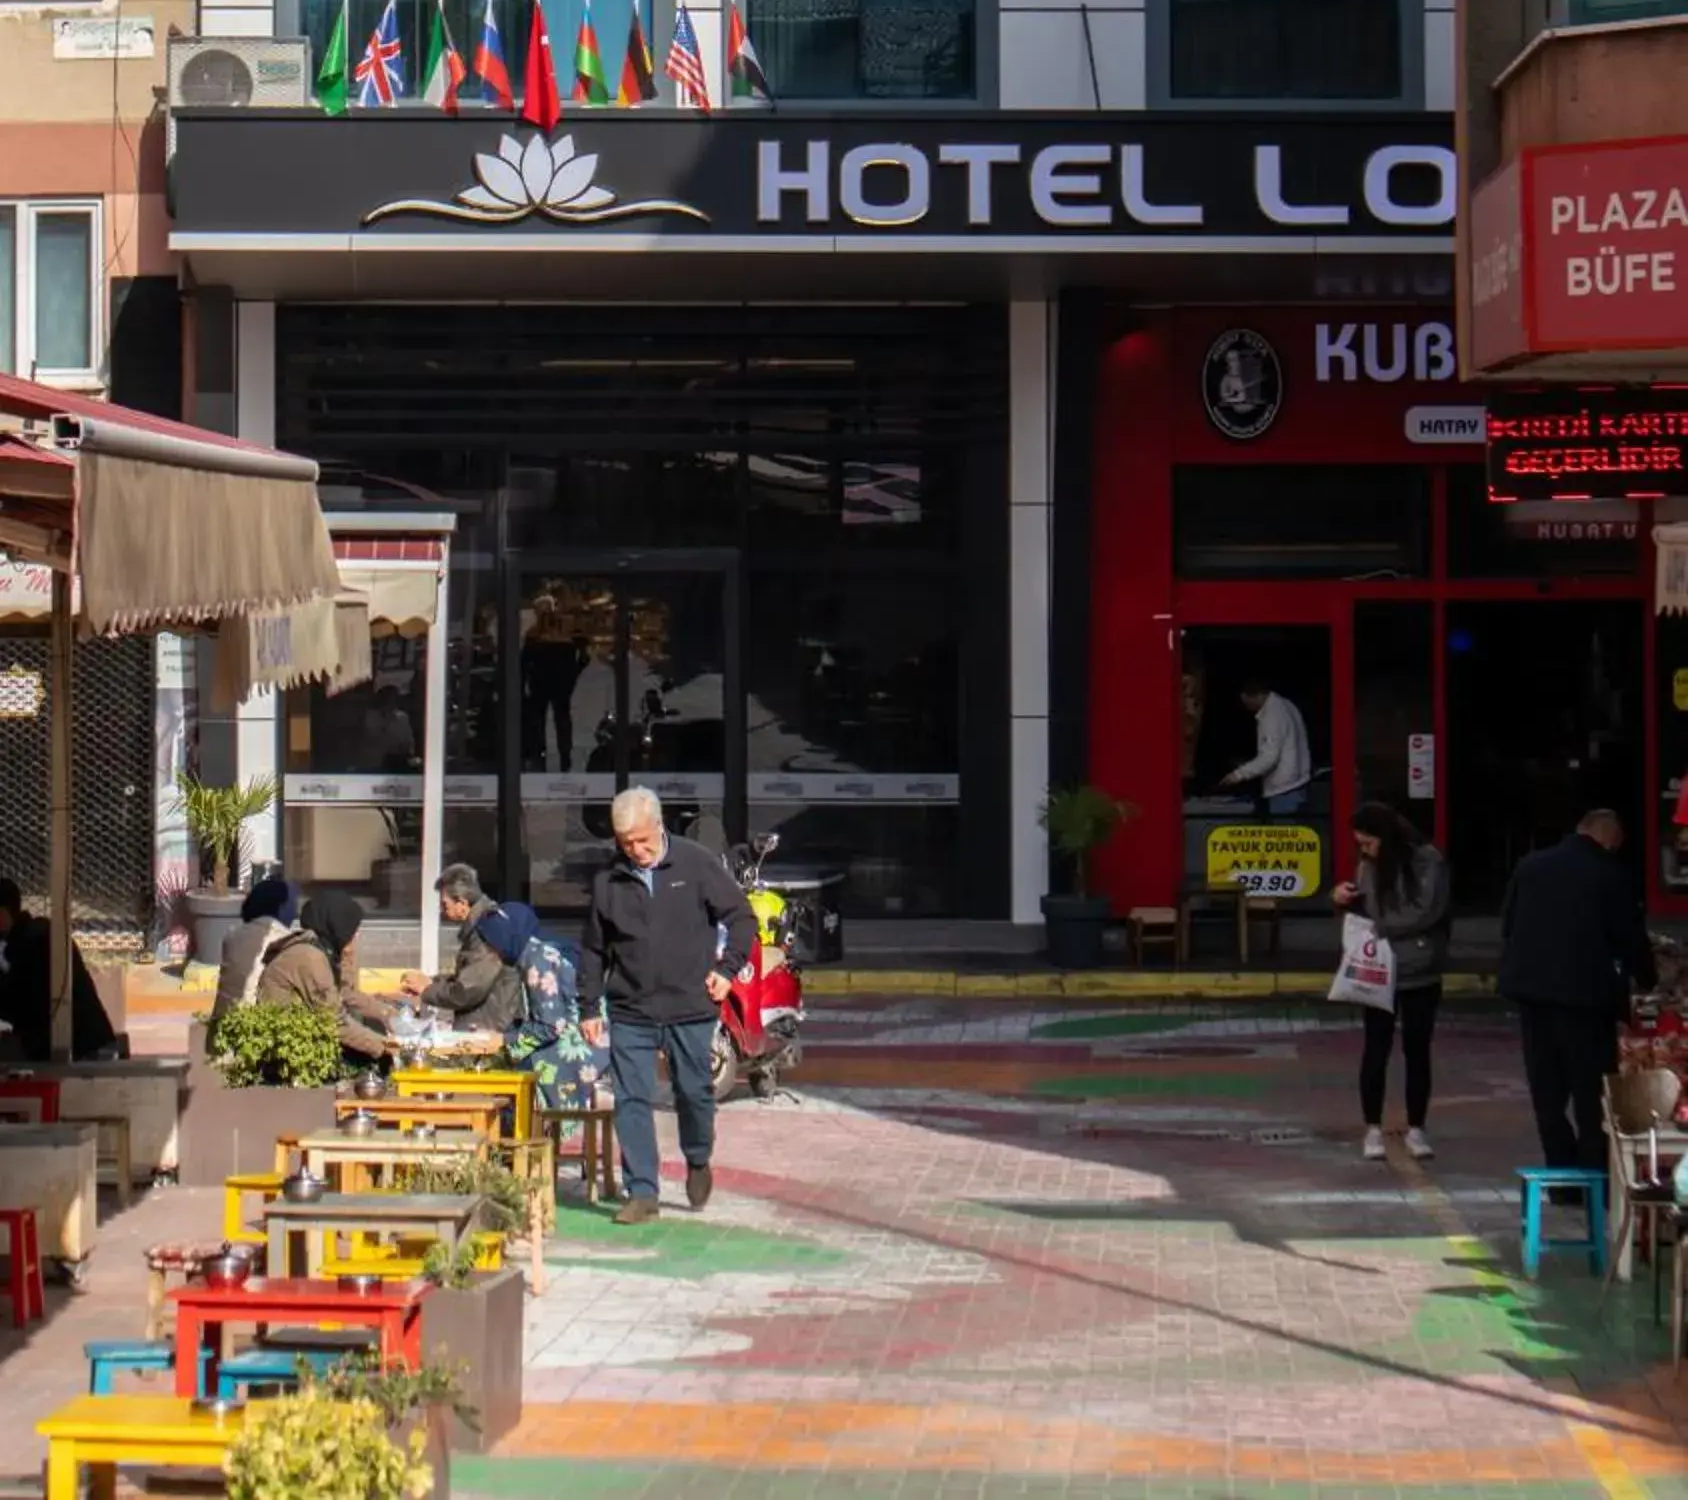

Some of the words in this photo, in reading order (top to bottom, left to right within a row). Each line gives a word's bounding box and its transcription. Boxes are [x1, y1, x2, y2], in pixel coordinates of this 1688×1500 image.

[756, 140, 1203, 226] HOTEL
[1253, 143, 1457, 227] LO
[1551, 187, 1688, 235] PLAZA
[1566, 245, 1676, 296] BÜFE
[1315, 322, 1456, 383] KUB
[1419, 419, 1479, 435] HATAY
[1211, 841, 1261, 853] TAVUK
[1231, 859, 1299, 869] AYRAN
